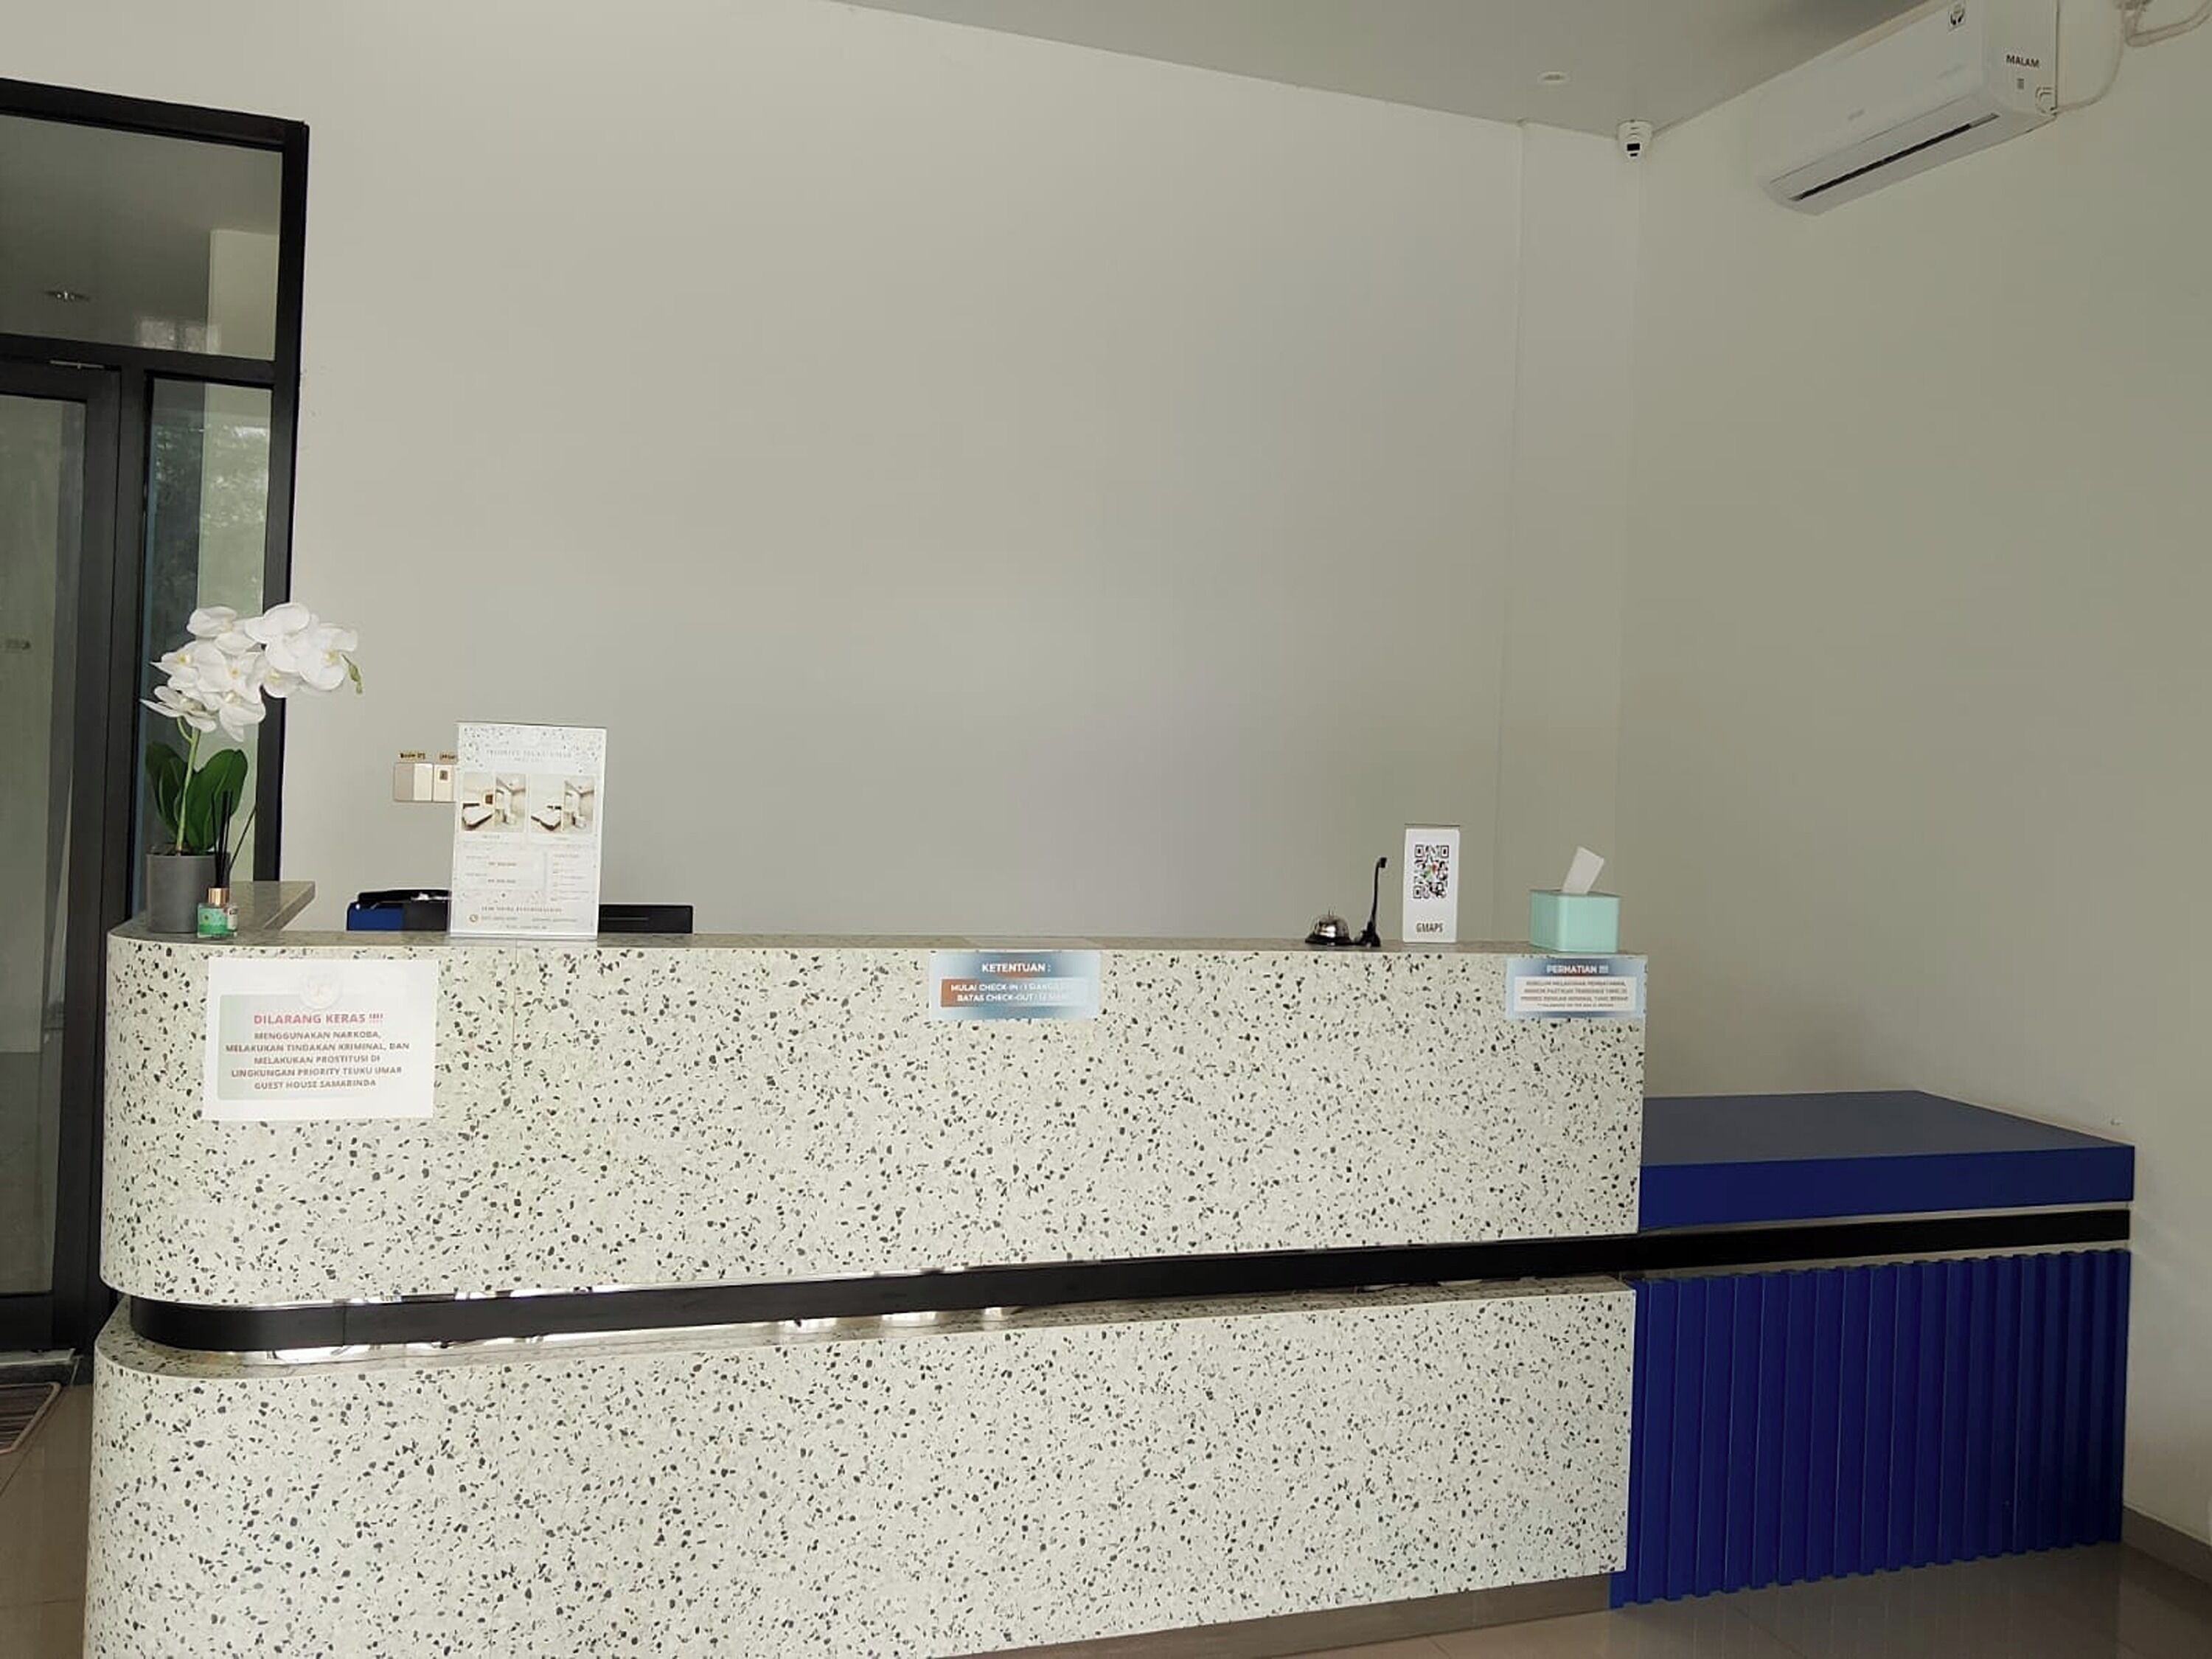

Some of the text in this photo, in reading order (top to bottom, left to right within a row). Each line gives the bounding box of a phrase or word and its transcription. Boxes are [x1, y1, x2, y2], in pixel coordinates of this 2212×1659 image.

[2006, 54, 2040, 69] MALAM
[1416, 922, 1443, 933] GMAPS
[981, 963, 1046, 973] KETENTUAN
[254, 1014, 322, 1025] DILARANG
[326, 1013, 366, 1024] KERAS
[254, 1032, 330, 1040] MENGGUNAKAN
[226, 1044, 284, 1052] MELAKUKAN
[287, 1043, 335, 1051] TINDAKAN
[254, 1054, 380, 1065] MELAKUKAN PROSTITUSI DI
[232, 1066, 402, 1077] LINGKUNGAN PRIORITY TEUKU UMAR
[254, 1079, 376, 1090] GUEST HOUSE SAMARINDA
